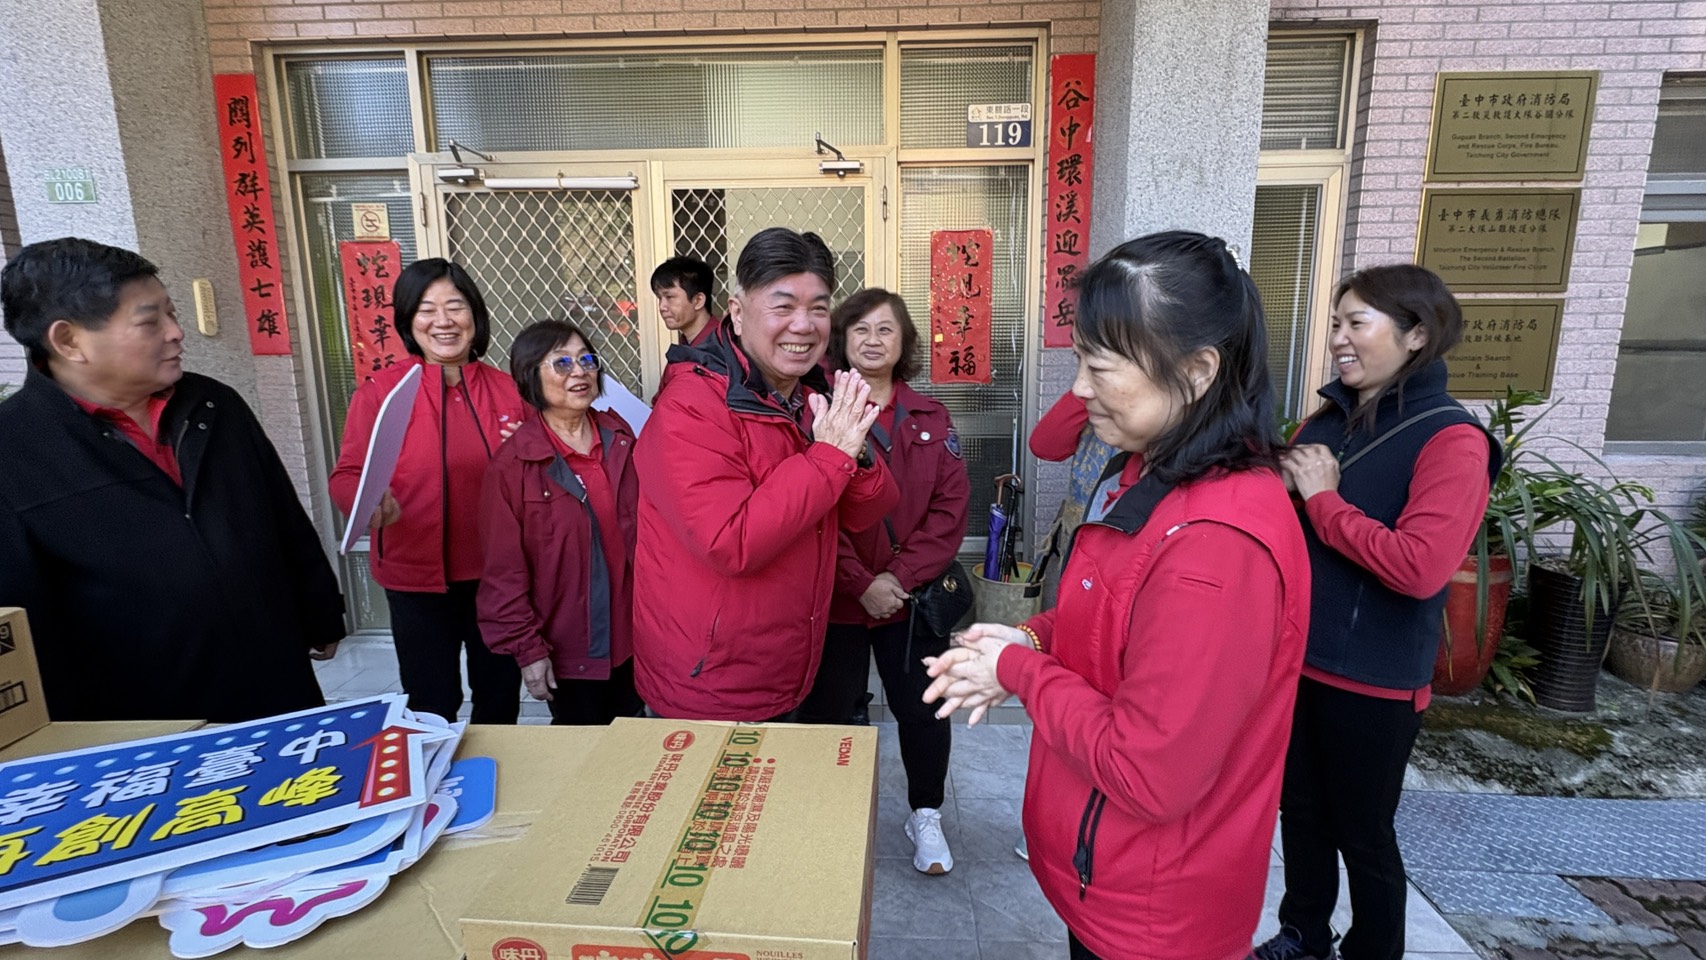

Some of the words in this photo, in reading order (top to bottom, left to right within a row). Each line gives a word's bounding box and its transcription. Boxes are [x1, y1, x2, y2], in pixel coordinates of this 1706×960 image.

[1458, 92, 1571, 107] 臺中市政府消防局
[986, 105, 1029, 114] 東關路一段
[979, 122, 1022, 146] 119
[1530, 132, 1567, 141] Emergency
[1466, 152, 1494, 160] Taichung
[1495, 152, 1509, 160] City
[55, 182, 84, 201] 006
[1437, 207, 1561, 222] 臺中市義勇消防總隊
[1463, 246, 1499, 254] Emergency
[1462, 318, 1538, 332] 市政府消防局
[1464, 334, 1523, 344] 救助訓練基地
[670, 732, 688, 750] 味丹
[731, 730, 761, 746] 10
[722, 751, 753, 768] 10
[836, 736, 853, 766] VEDAN
[654, 753, 668, 772] VEDAN
[0, 729, 347, 826] 幸福臺中
[631, 772, 659, 810] ENTERPRISE
[611, 753, 684, 863] 味丹企業股份有限公司
[601, 810, 637, 863] CORPORATION
[668, 864, 708, 887] 10
[650, 899, 694, 928] 10
[756, 950, 803, 959] NOUILLES
